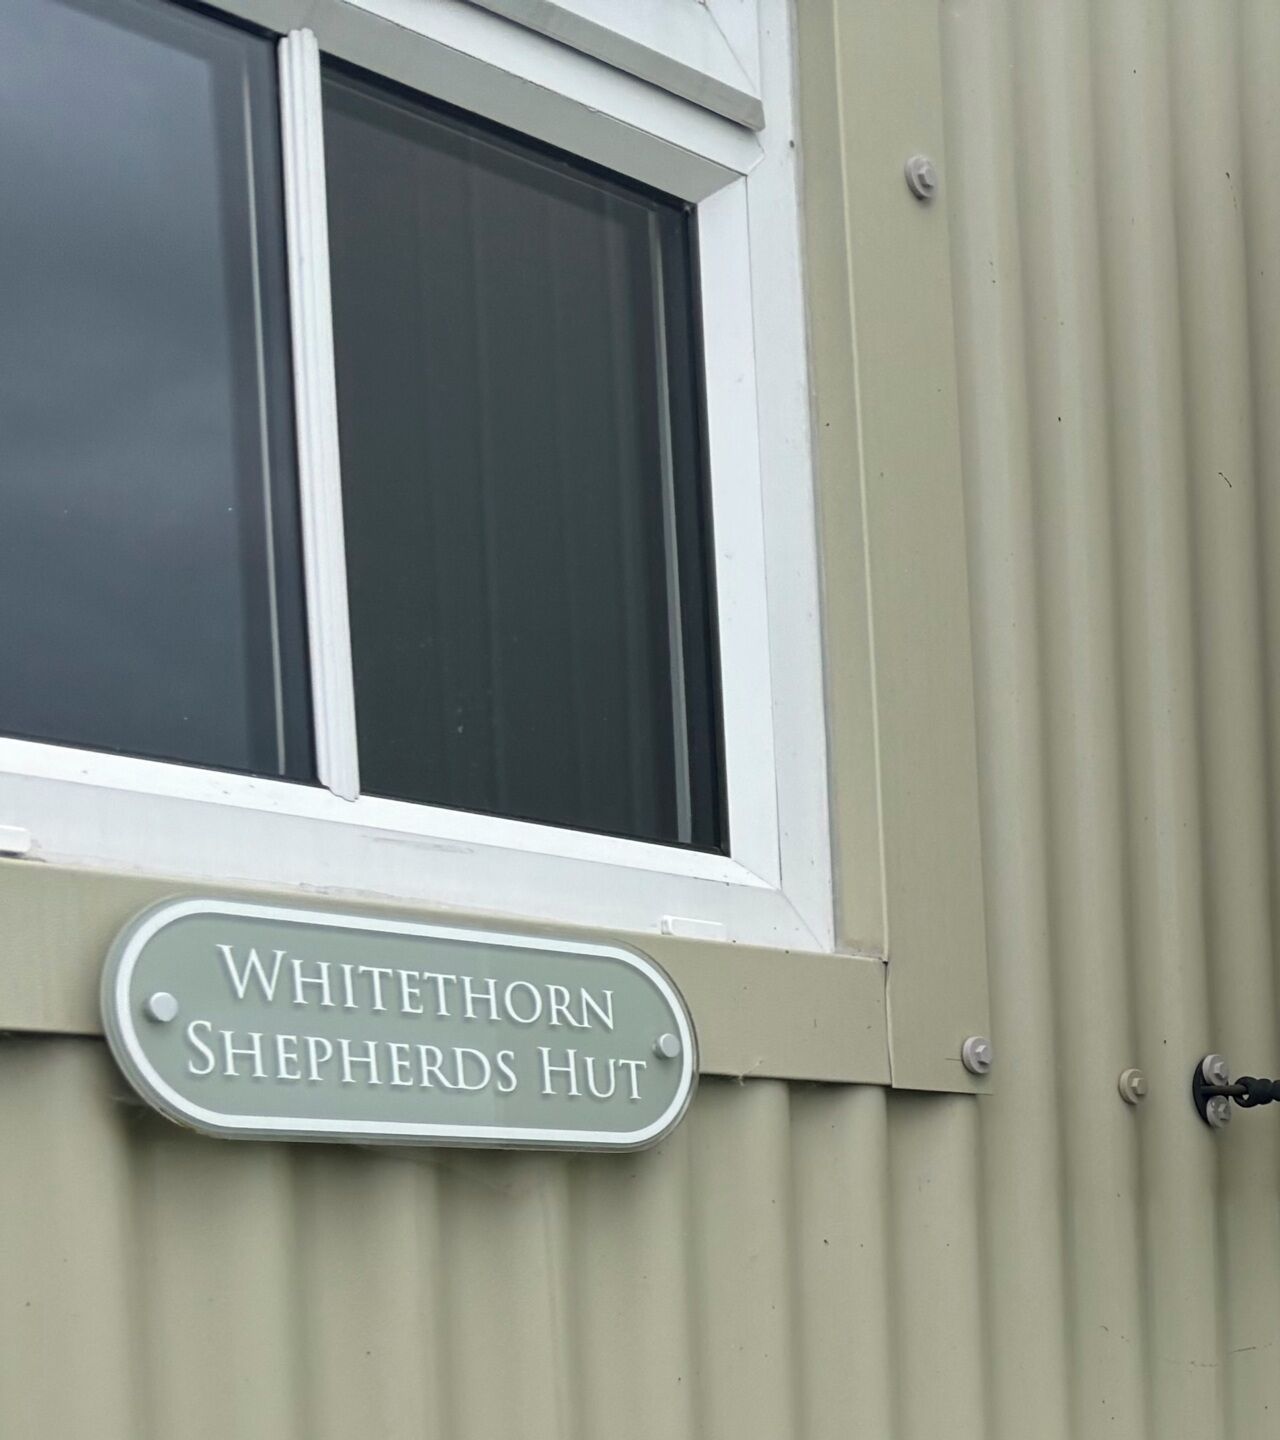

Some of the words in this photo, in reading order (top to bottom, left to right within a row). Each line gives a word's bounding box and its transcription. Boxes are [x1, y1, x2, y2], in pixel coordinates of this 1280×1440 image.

[216, 943, 616, 1031] WHITETHORN
[186, 1020, 518, 1093] SHEPHERDS
[537, 1047, 647, 1100] HUT
